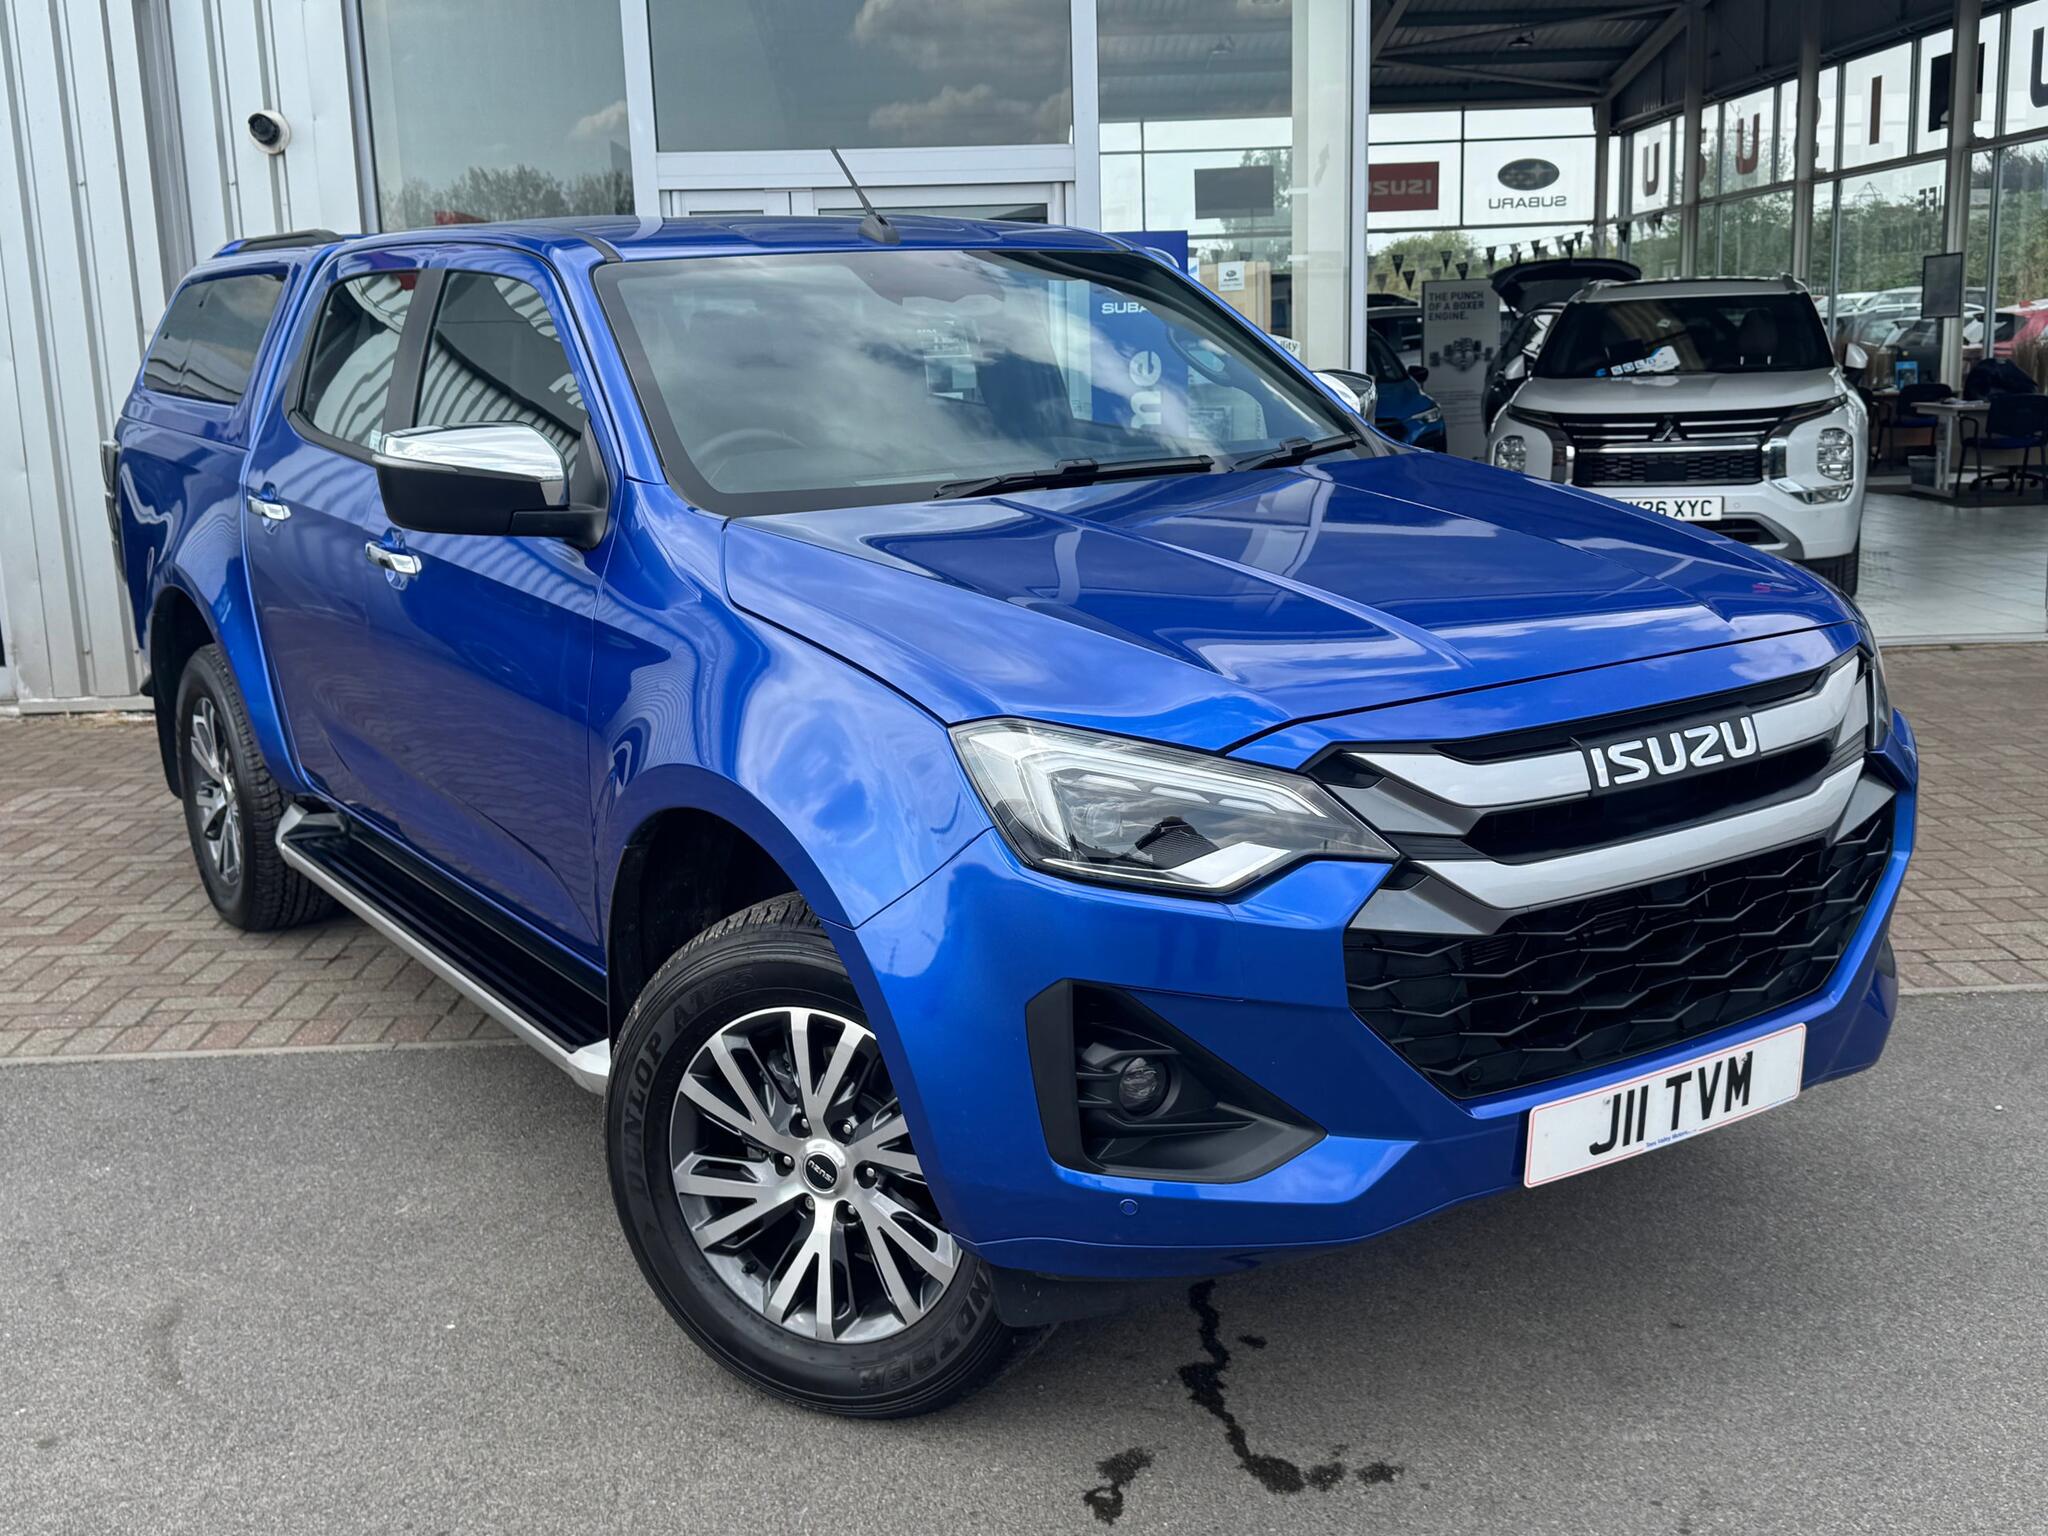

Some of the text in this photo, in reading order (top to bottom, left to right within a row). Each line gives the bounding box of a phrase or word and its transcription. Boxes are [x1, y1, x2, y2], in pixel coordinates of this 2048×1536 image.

[1428, 290, 1484, 301] THE PUNCH
[1428, 301, 1485, 311] OF A BOXER
[1674, 500, 1712, 517] XYC
[1590, 716, 1757, 788] ISUZU
[1666, 1051, 1753, 1131] TVM
